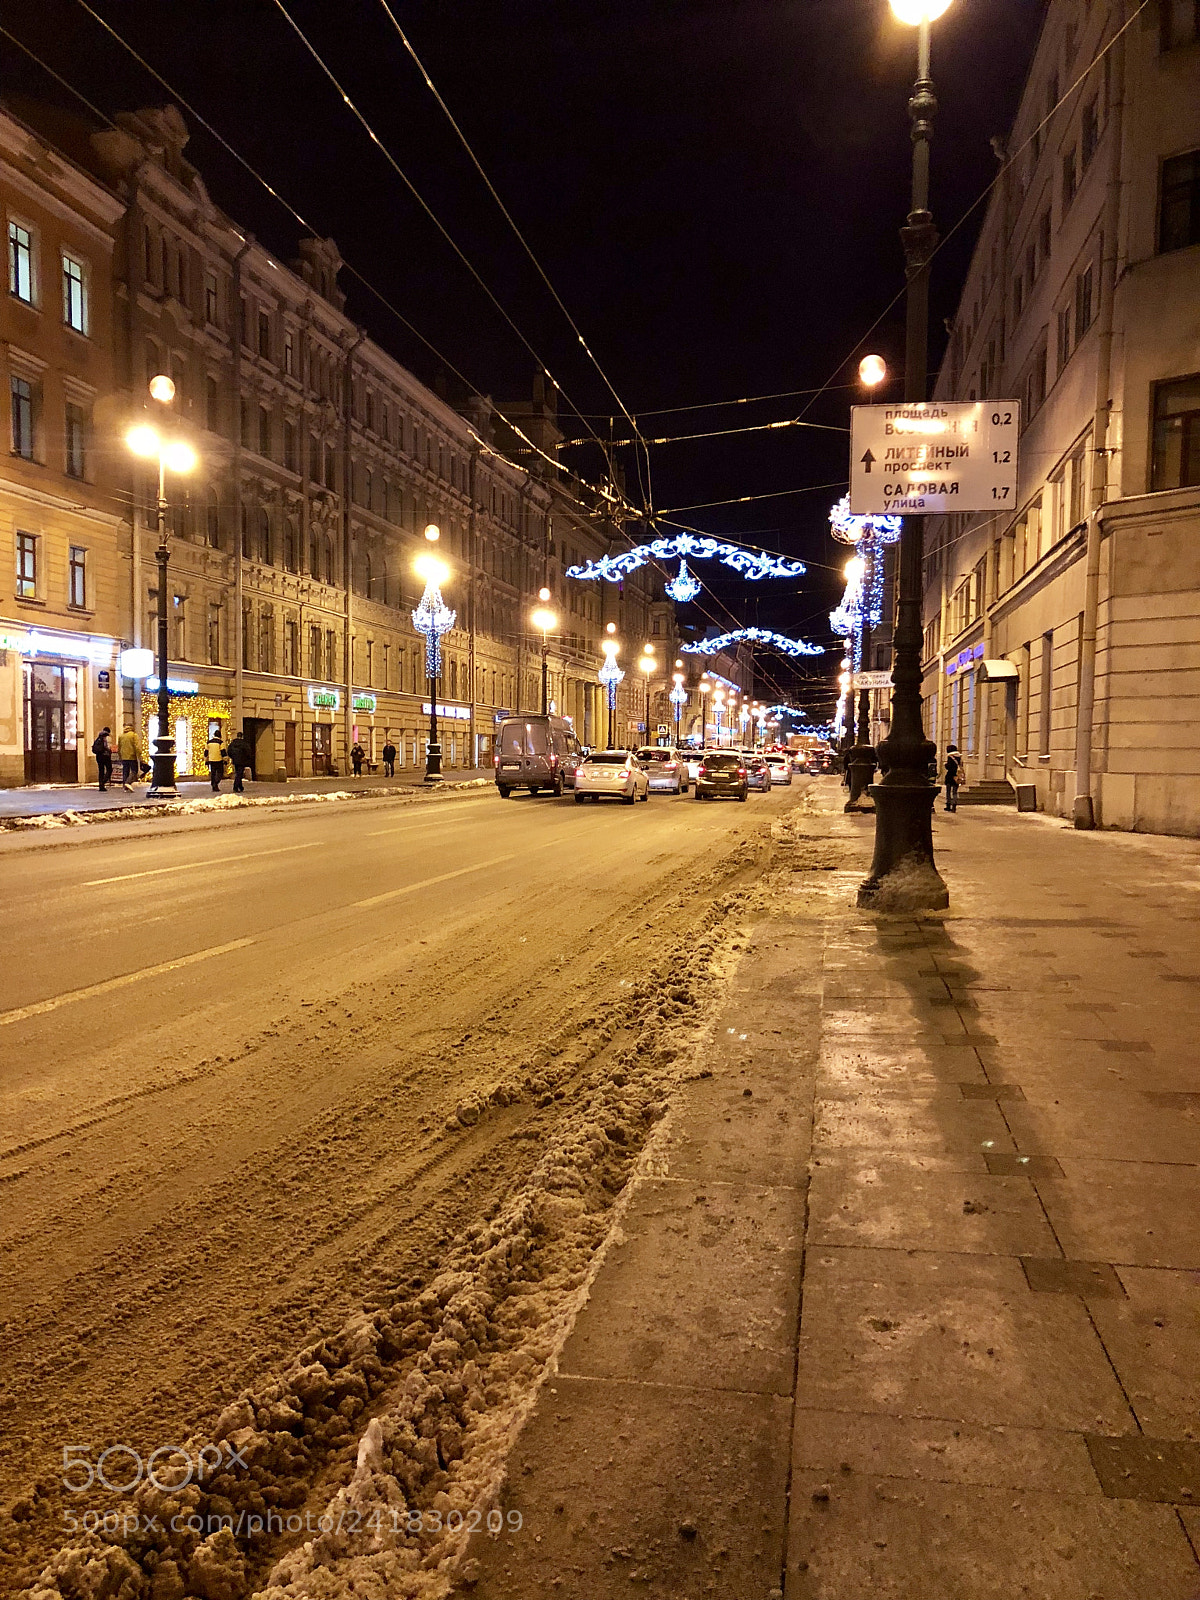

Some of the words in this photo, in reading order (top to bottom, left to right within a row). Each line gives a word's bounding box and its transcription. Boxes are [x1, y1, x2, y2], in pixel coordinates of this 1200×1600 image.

[885, 409, 948, 420] площадь
[991, 412, 1012, 426] 0,2
[992, 451, 1011, 465] 1,2
[991, 487, 1010, 501] 1,7
[884, 499, 926, 511] улица
